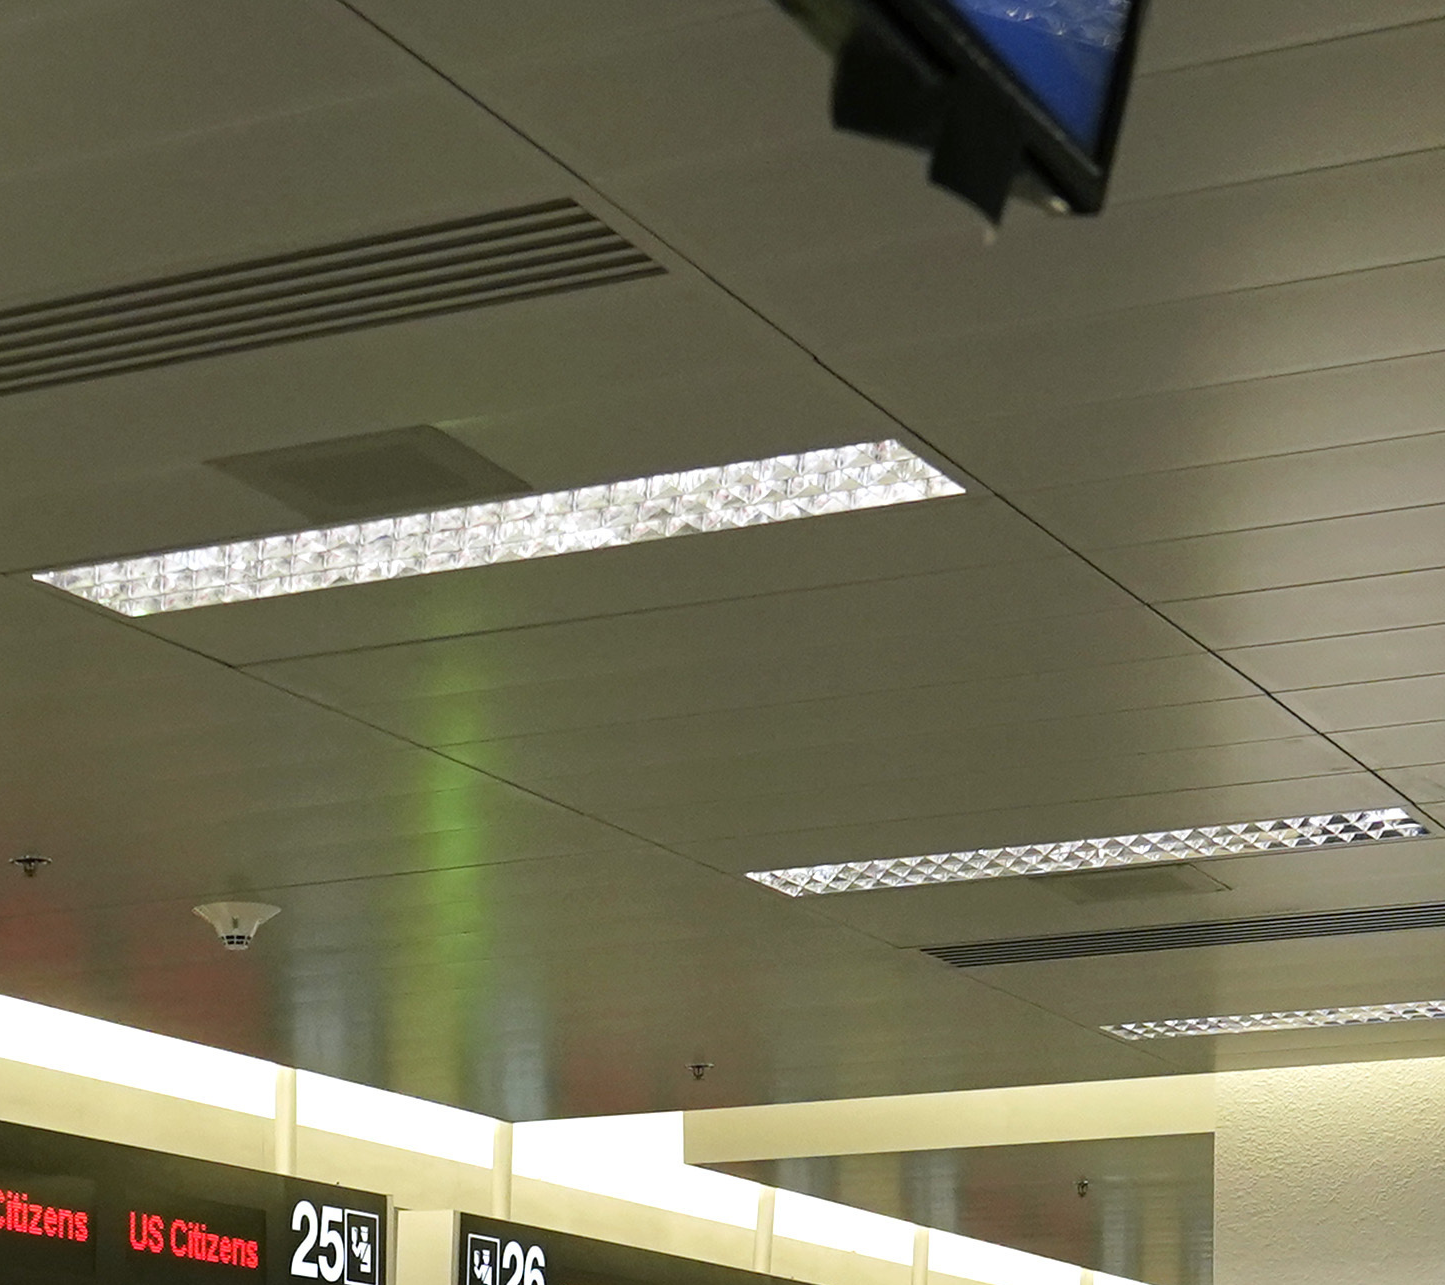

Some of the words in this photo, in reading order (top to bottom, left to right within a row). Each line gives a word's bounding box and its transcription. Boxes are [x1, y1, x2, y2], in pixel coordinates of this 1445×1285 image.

[129, 1211, 165, 1254] US
[170, 1218, 258, 1269] Citizens
[290, 1200, 345, 1283] 25
